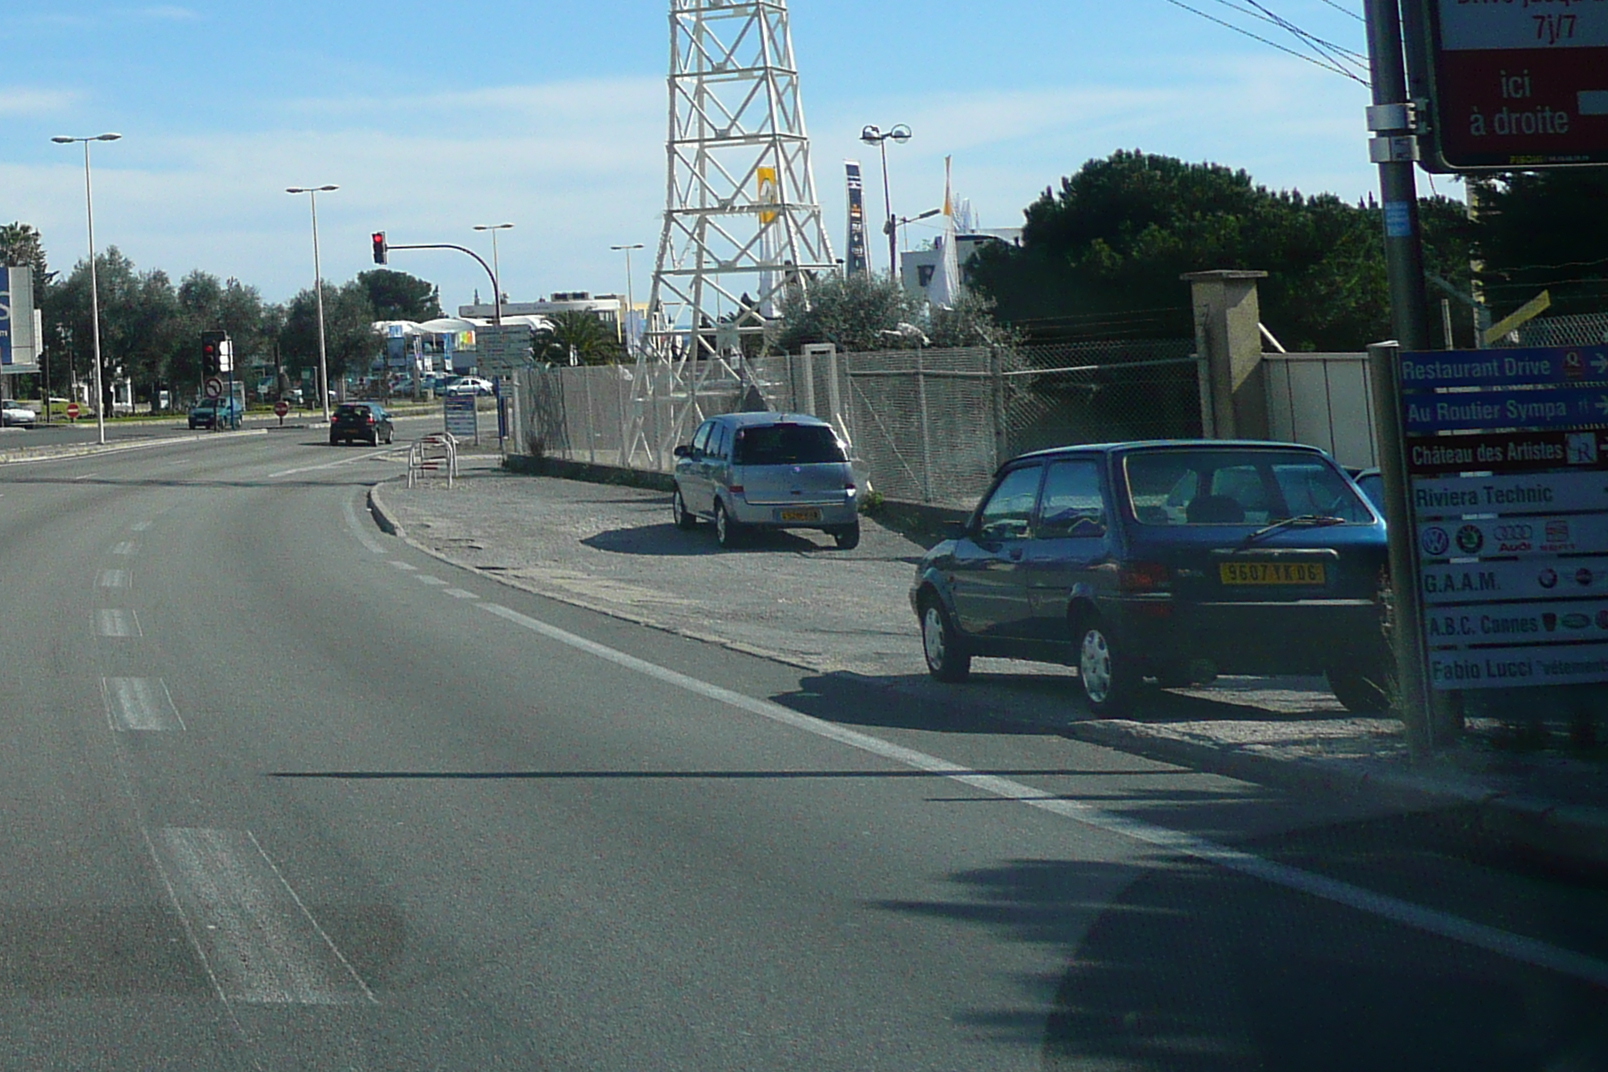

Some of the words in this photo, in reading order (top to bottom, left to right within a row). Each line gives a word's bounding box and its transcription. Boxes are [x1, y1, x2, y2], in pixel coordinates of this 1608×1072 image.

[1532, 14, 1578, 46] 7j/7
[1500, 69, 1532, 99] ici
[1469, 106, 1487, 136] à
[1494, 106, 1570, 135] droite
[1402, 359, 1500, 381] Restaurant
[1504, 356, 1551, 377] Drive
[1408, 403, 1432, 423] Au
[1436, 401, 1500, 421] Routier
[1506, 399, 1567, 422] Sympa
[1412, 445, 1473, 466] Château
[1477, 442, 1503, 463] des
[1507, 440, 1563, 461] Artistes
[1415, 487, 1478, 507] Riviera
[1482, 484, 1554, 505] Technic
[1297, 563, 1316, 581] 06
[1424, 571, 1501, 594] G.A.A.M.
[1430, 615, 1476, 636] A.B.C.
[1480, 613, 1539, 635] Cannes
[1431, 660, 1480, 680] Fabio
[1485, 657, 1533, 679] Lucci
